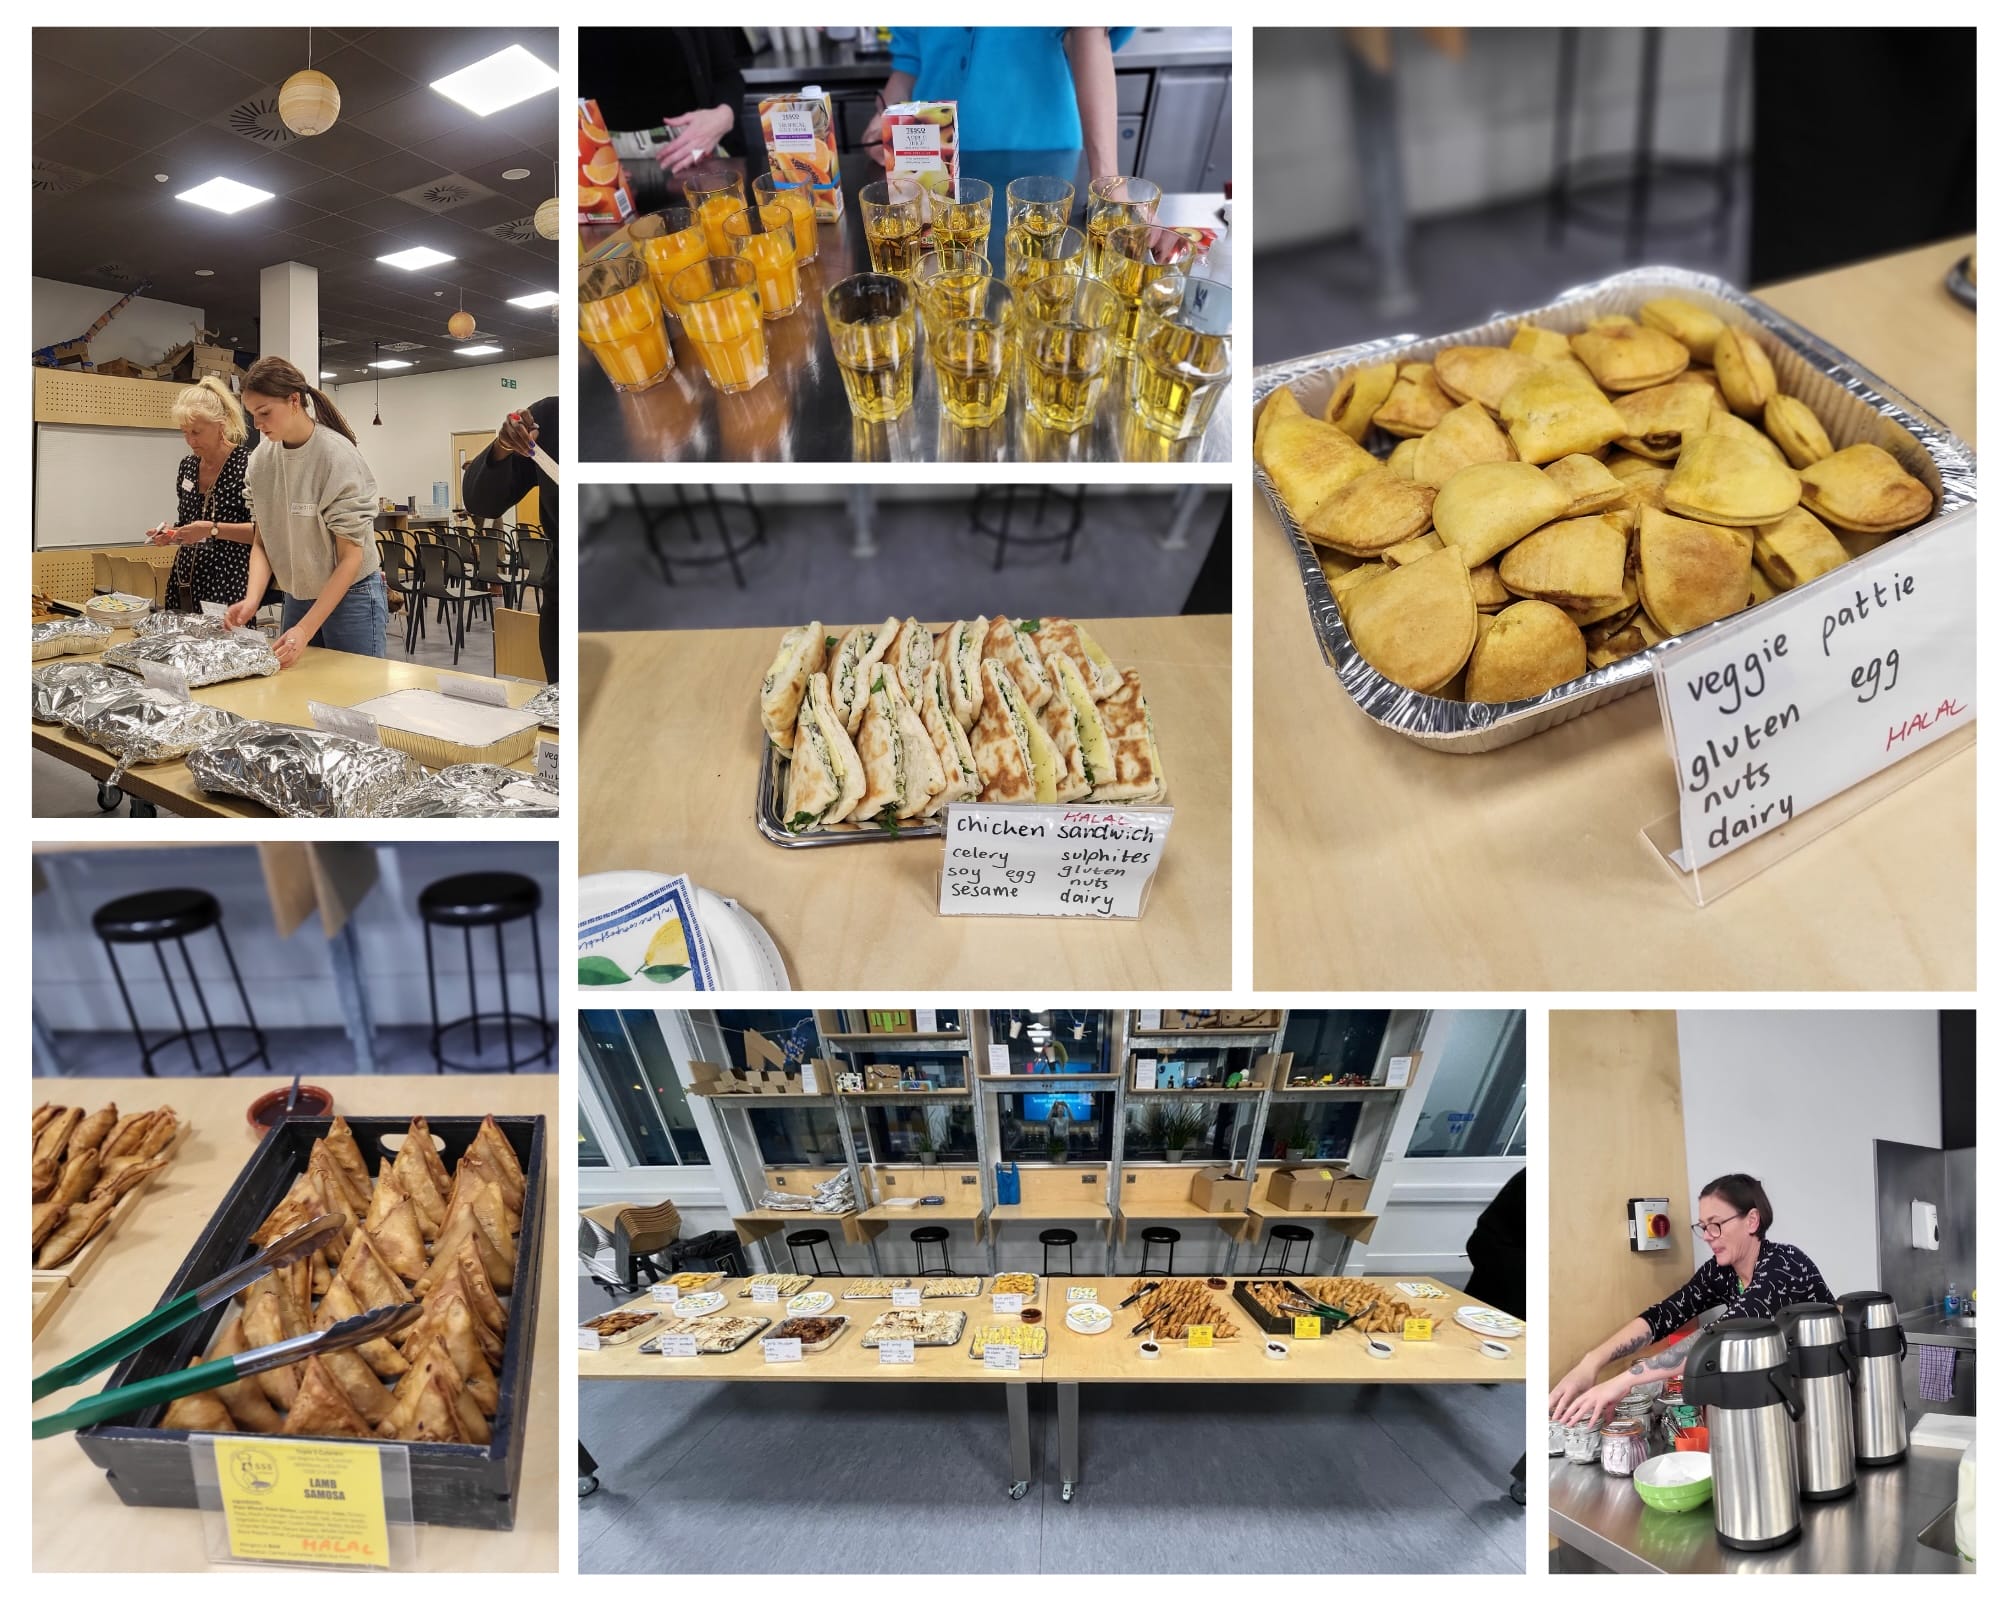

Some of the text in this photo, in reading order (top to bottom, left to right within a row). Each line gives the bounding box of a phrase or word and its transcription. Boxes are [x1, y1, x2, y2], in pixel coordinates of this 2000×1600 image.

[1687, 573, 1915, 714] veggie pattie
[1851, 649, 1900, 703] egg
[1886, 699, 1968, 752] HALAL
[1689, 704, 1800, 792] gluten
[1704, 762, 1770, 814] nuts
[1063, 812, 1131, 825] HALAL
[1709, 795, 1793, 849] dairy
[1057, 824, 1154, 844] sandwich
[952, 847, 1151, 869] celery sulphites
[947, 864, 1126, 884] soy egg gluten
[1069, 877, 1109, 890] nuts
[951, 882, 1114, 915] sesame dairy
[309, 1477, 338, 1489] LAMB
[303, 1489, 346, 1501] SAMOSA
[303, 1538, 374, 1556] HALAL
